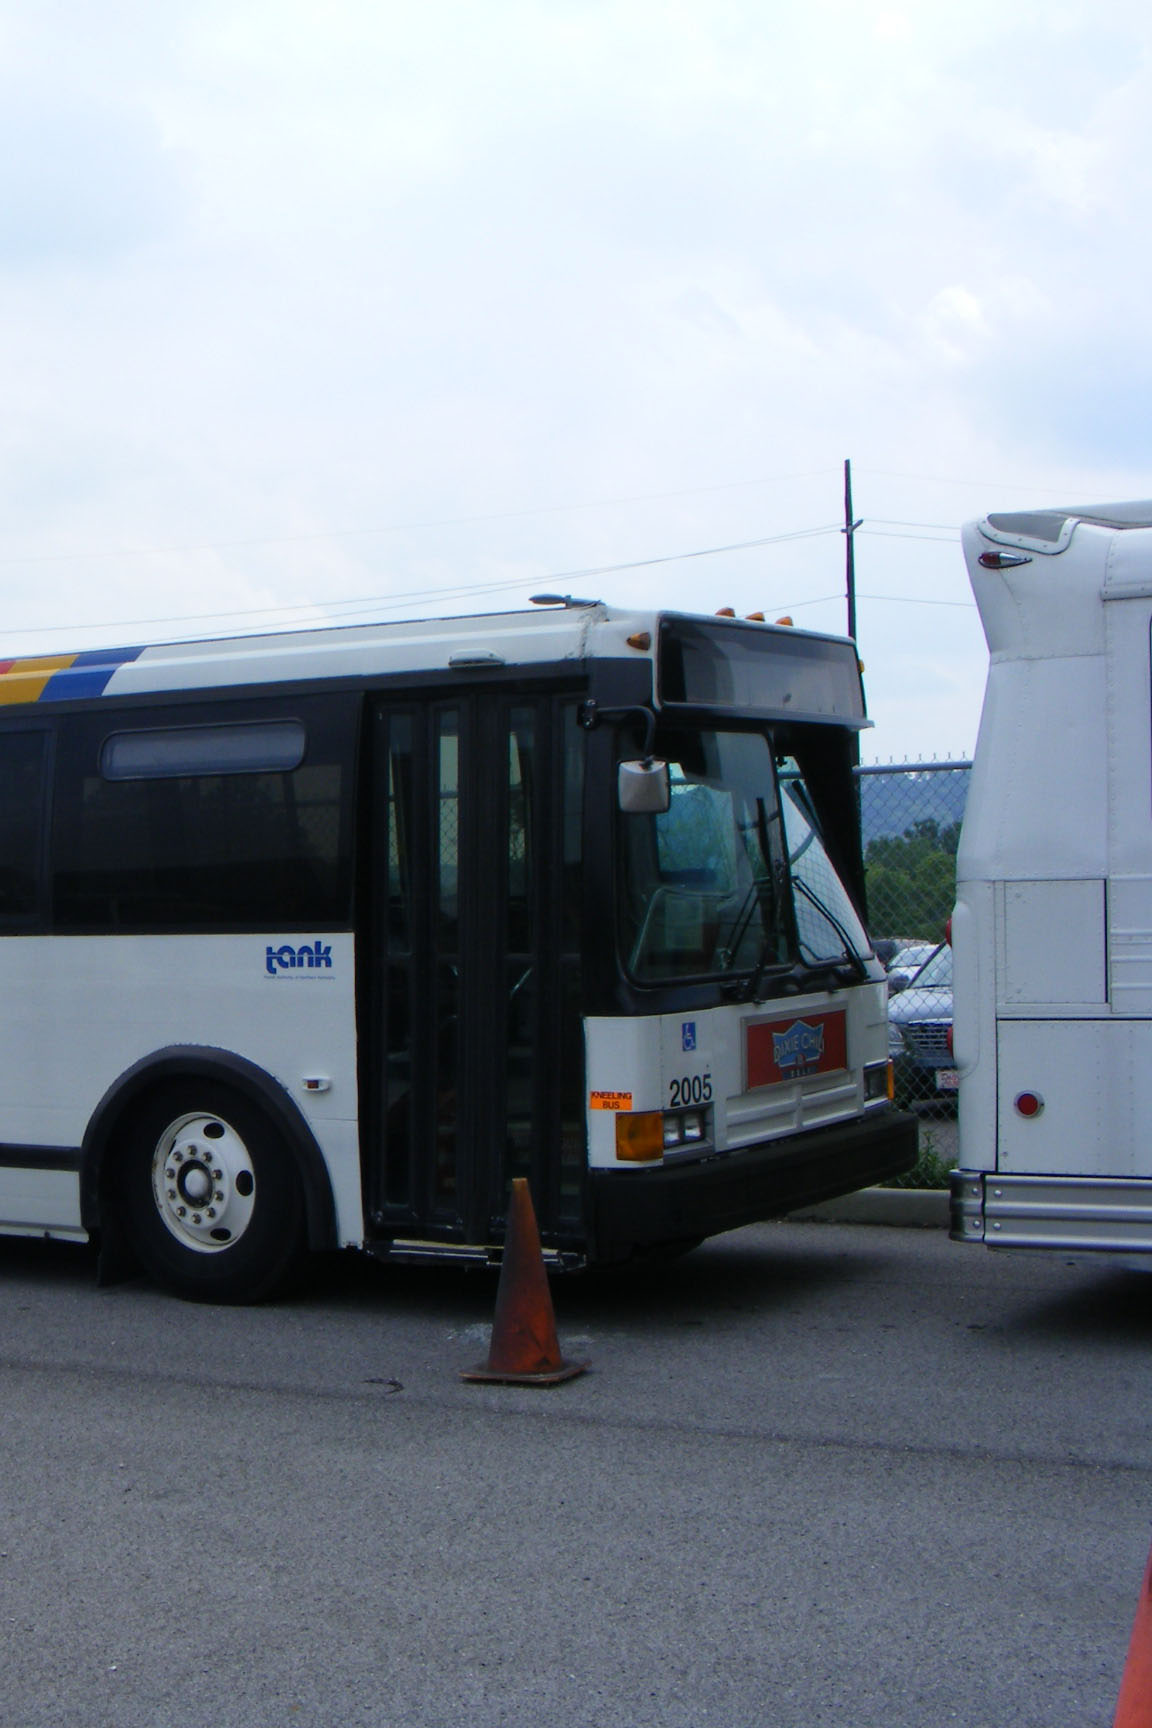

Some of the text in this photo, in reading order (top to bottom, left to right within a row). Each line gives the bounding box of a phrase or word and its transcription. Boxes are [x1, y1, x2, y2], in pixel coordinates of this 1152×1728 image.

[266, 941, 332, 975] tank
[774, 1033, 800, 1064] DIXIE
[591, 1091, 632, 1100] KNEELING
[602, 1101, 620, 1110] BUS
[670, 1073, 712, 1107] 2005
